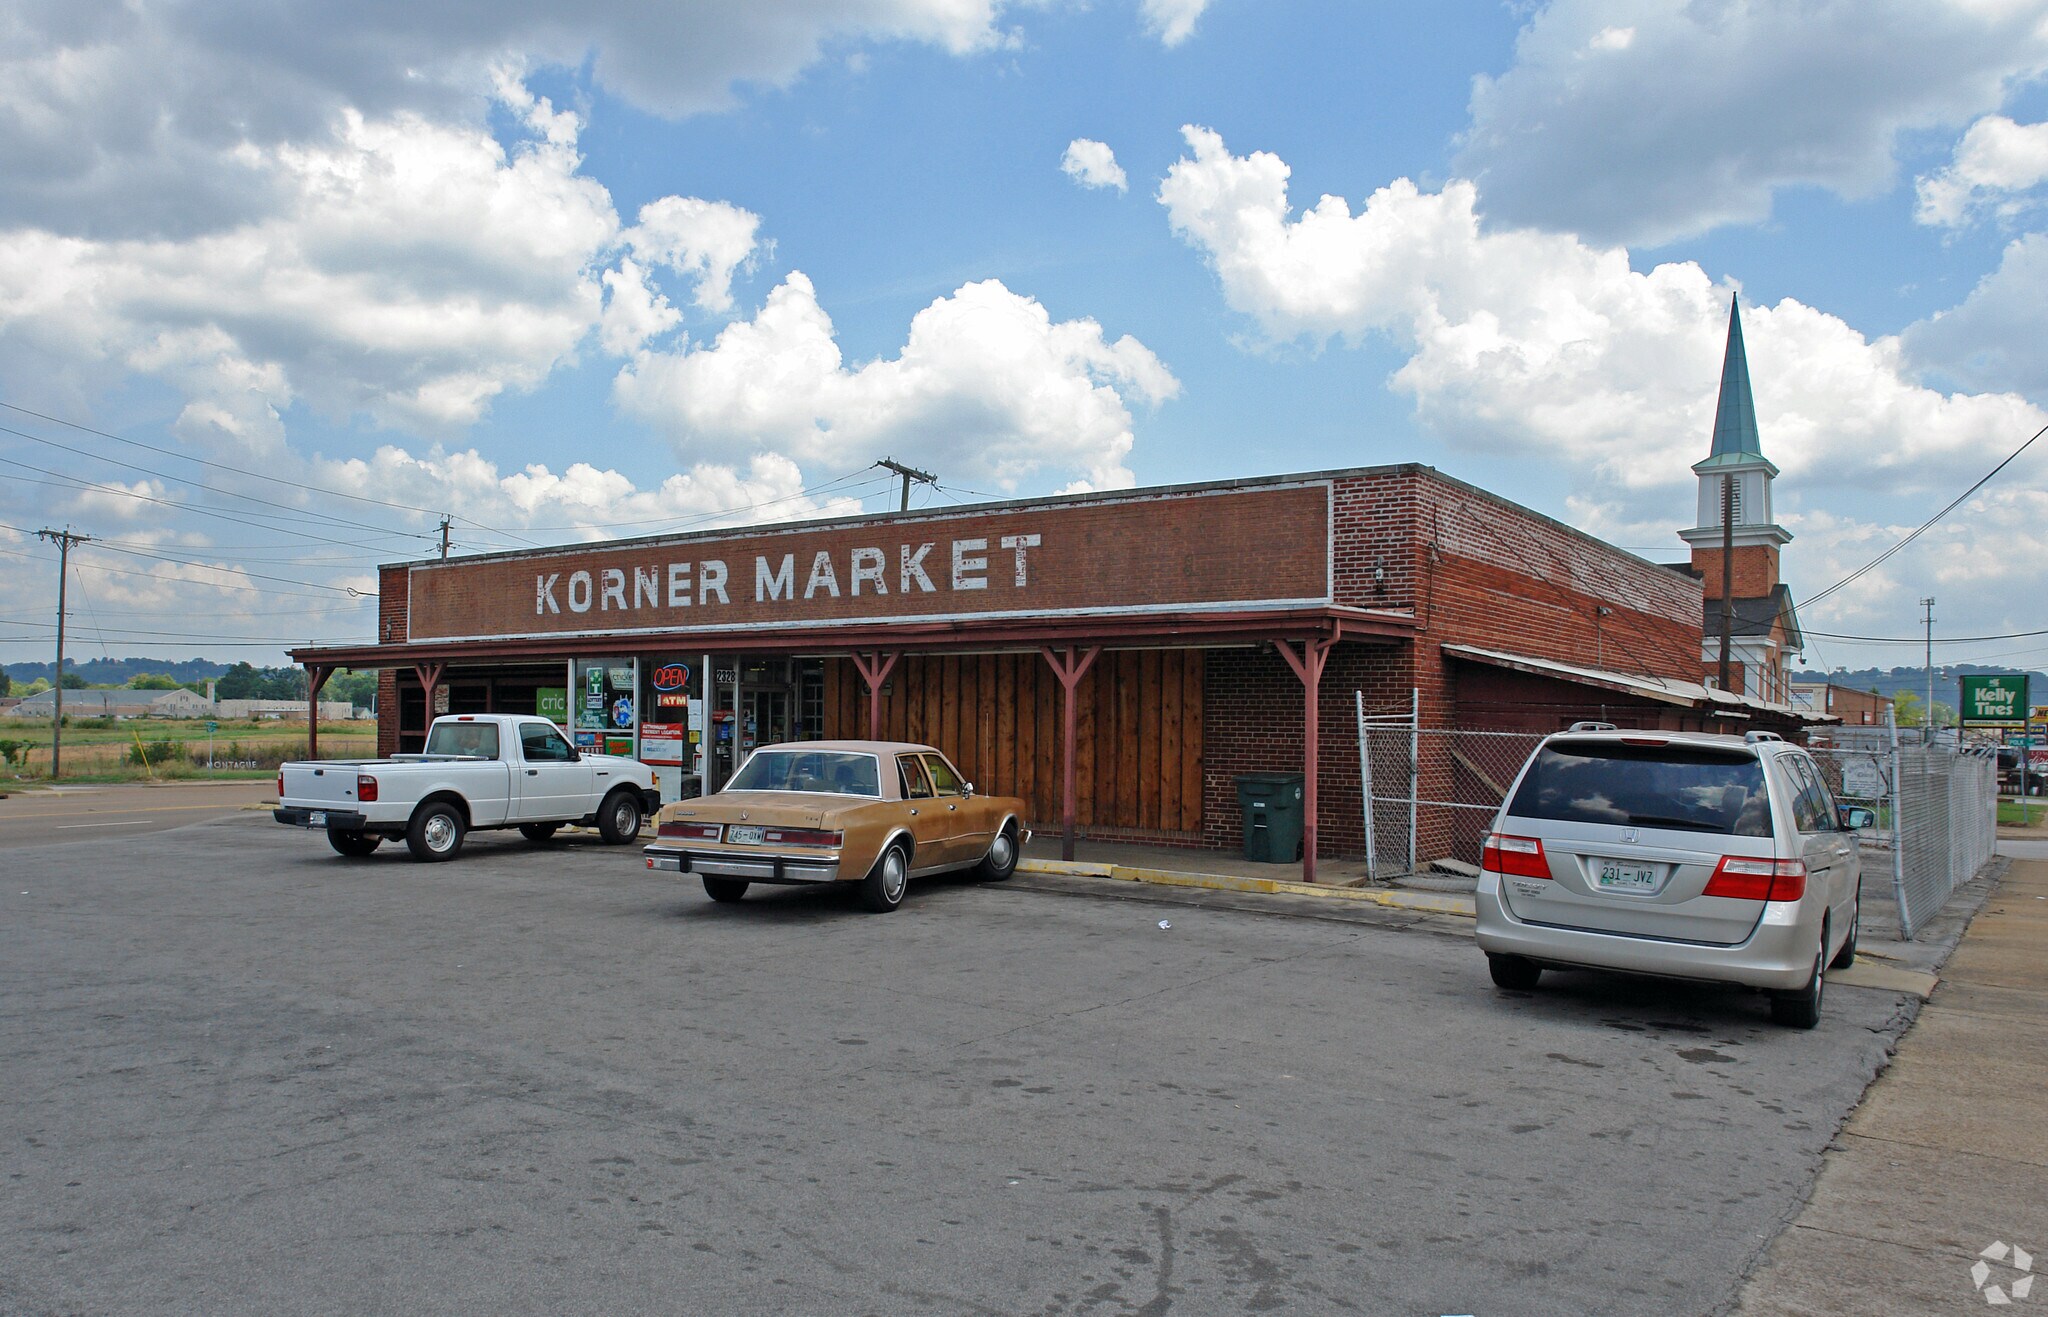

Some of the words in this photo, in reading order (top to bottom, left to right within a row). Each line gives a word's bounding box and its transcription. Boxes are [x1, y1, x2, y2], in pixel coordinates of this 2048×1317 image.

[536, 559, 730, 615] KORNER
[755, 533, 1042, 602] MARKET
[653, 668, 687, 686] OPEN
[717, 670, 736, 683] 2328
[662, 696, 686, 705] ATM
[1975, 687, 2016, 704] Kelly
[1974, 702, 2015, 716] Tires
[206, 760, 257, 769] MONTAGUE
